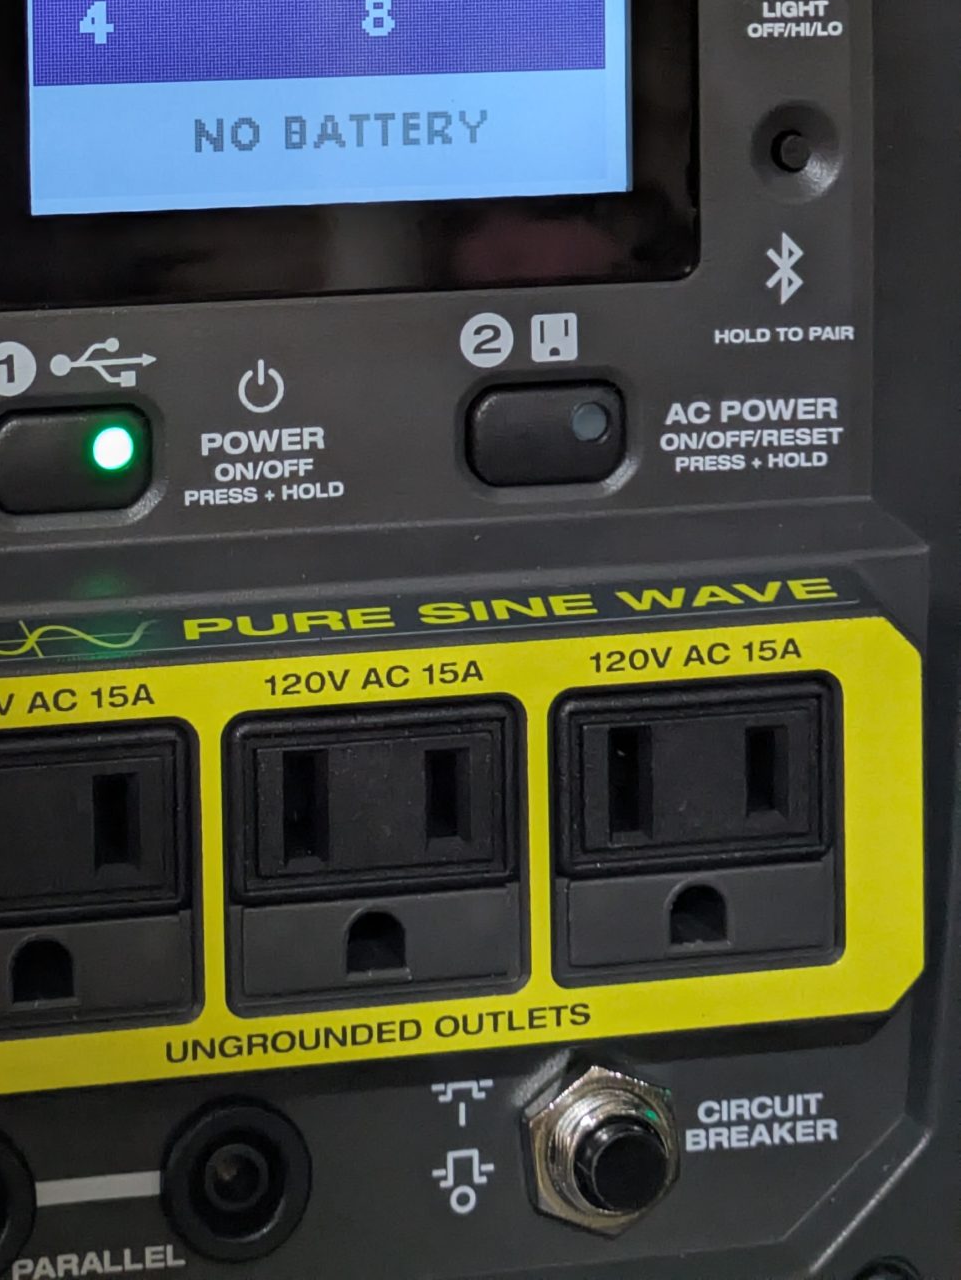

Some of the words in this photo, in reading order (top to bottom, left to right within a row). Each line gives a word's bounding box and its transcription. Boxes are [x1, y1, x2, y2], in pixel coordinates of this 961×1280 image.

[80, 1, 114, 44] 4
[763, 0, 829, 18] LIGHT
[748, 21, 842, 37] OFF/HI/LO
[195, 118, 259, 152] NO
[285, 110, 487, 150] BATTERY
[715, 328, 770, 343] HOLD
[776, 327, 803, 341] TO
[809, 326, 854, 340] PAIR
[665, 402, 710, 425] AC
[721, 398, 837, 422] POWER
[201, 426, 325, 452] POWER
[660, 428, 843, 451] ON/OFF/RESET
[214, 458, 314, 482] ON/OFF
[675, 454, 746, 472] PRESS
[752, 458, 762, 468] +
[768, 451, 828, 468] HOLD
[184, 487, 258, 506] PRESS
[265, 490, 275, 501] +
[282, 482, 344, 500] HOLD
[184, 607, 395, 640] PURE
[419, 594, 598, 625] SINE
[616, 578, 838, 612] WAVE
[590, 647, 672, 673] 120V
[683, 643, 730, 666] AC
[743, 637, 802, 662] 15A
[265, 669, 350, 695] 120V
[362, 665, 409, 689] AC
[423, 661, 483, 684] 15A
[27, 689, 77, 714] AC
[91, 684, 154, 708] 15A
[165, 1018, 422, 1064] UNGROUNDED
[434, 1003, 591, 1038] OUTLETS
[697, 1092, 824, 1124] CIRCUIT
[685, 1118, 838, 1152] BREAKER
[13, 1245, 185, 1280] PARALLEL
